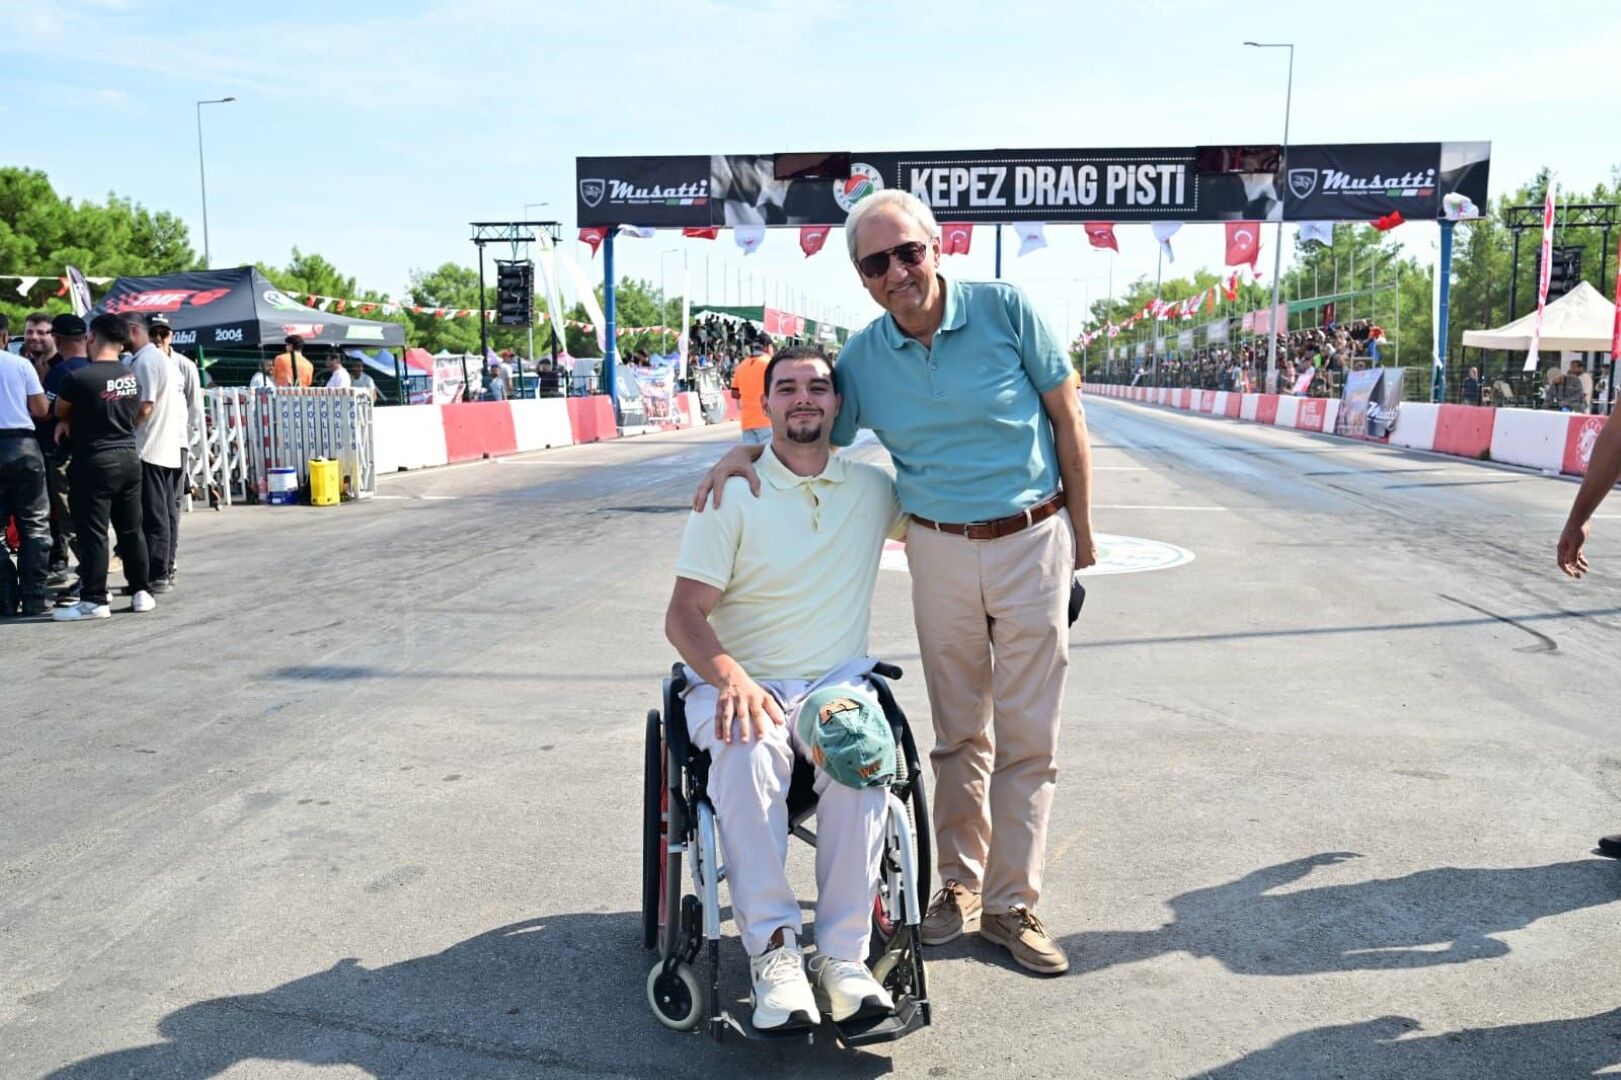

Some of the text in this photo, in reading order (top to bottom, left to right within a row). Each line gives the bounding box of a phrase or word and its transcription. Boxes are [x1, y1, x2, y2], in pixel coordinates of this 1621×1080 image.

[608, 179, 708, 198] Musatti
[911, 166, 1007, 207] KEPEZ
[1014, 165, 1098, 206] DRAG
[1321, 168, 1435, 190] Musatti
[215, 328, 243, 342] 2004
[106, 377, 137, 392] BOSS
